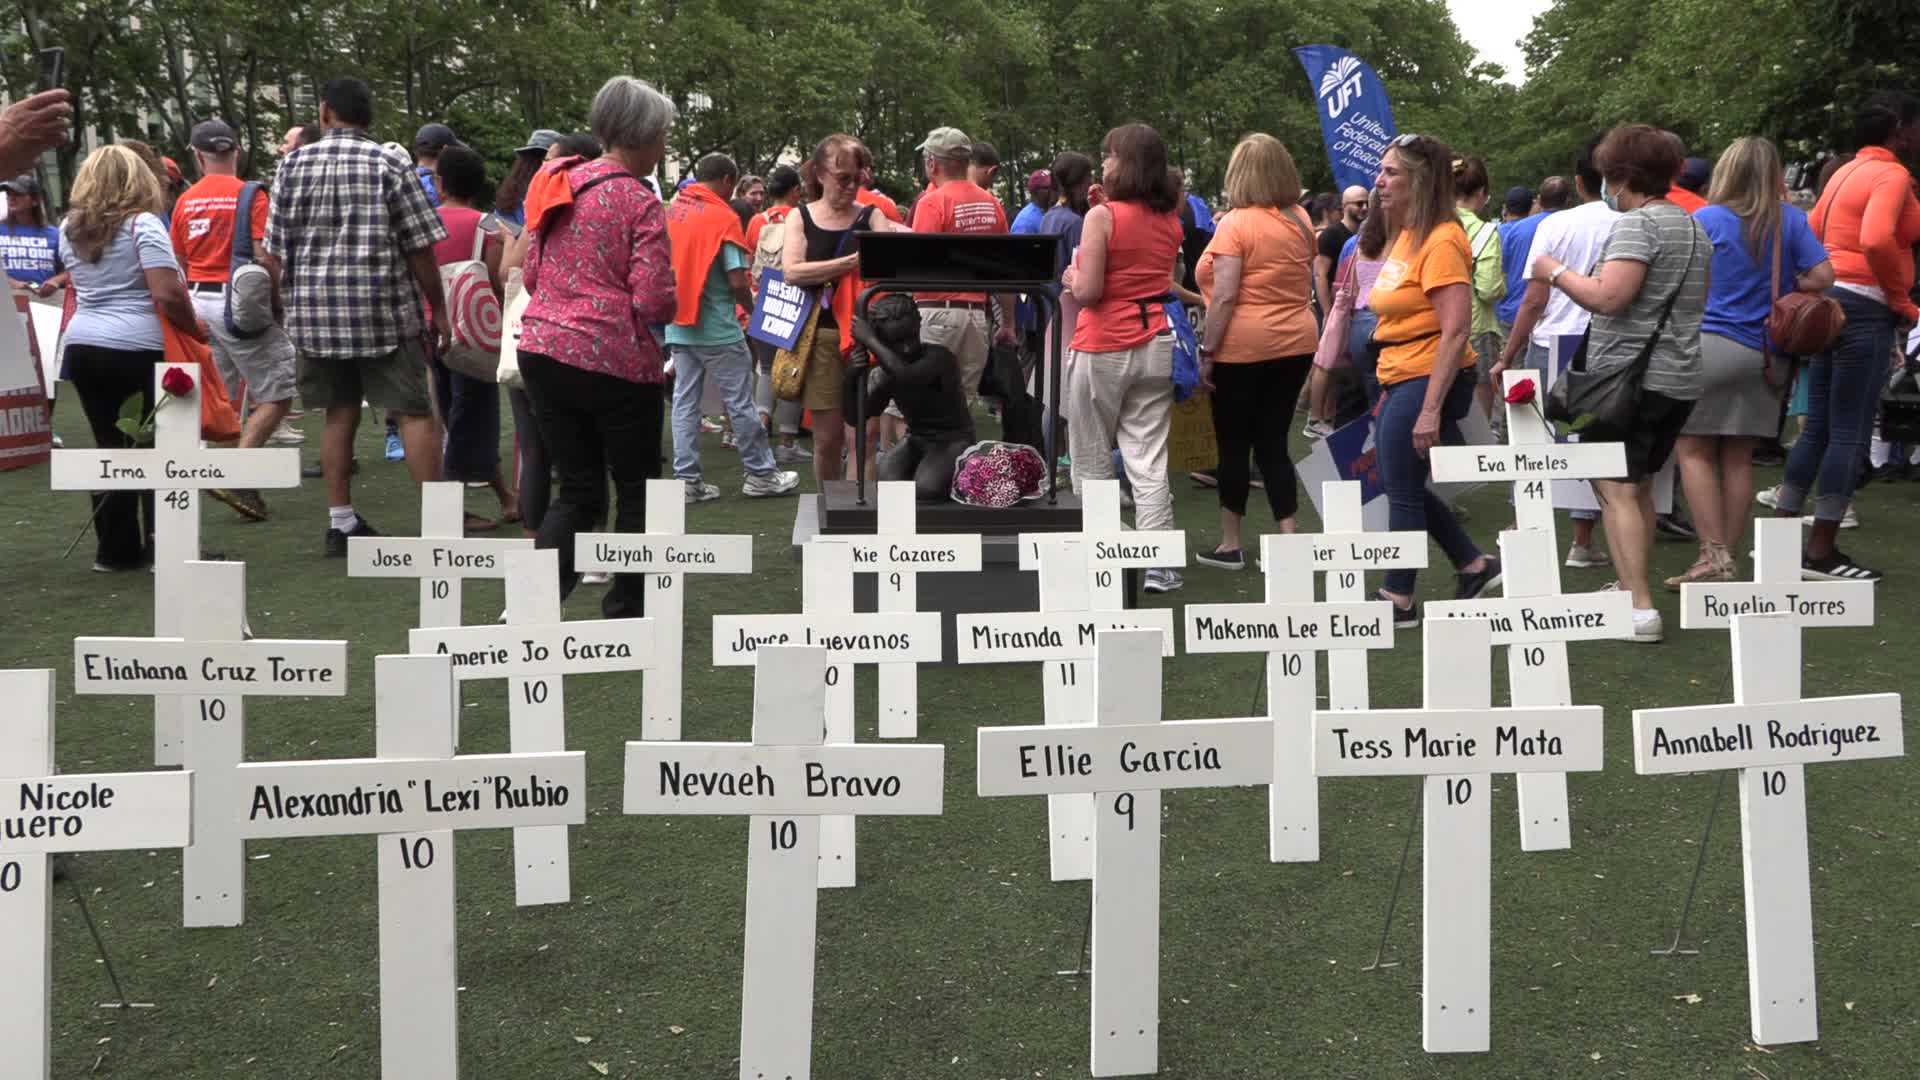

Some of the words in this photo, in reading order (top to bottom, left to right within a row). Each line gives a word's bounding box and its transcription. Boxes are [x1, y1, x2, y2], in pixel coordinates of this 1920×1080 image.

[1327, 71, 1362, 119] UFT
[1332, 139, 1353, 153] of
[0, 235, 48, 248] MARCH
[0, 246, 28, 258] FOR
[3, 258, 39, 270] LIVES
[780, 301, 802, 324] FOR
[99, 459, 146, 480] Irma
[165, 459, 225, 480] Garcia
[1477, 454, 1506, 472] Eva
[1515, 453, 1568, 471] Mireles
[164, 489, 190, 511] 48
[1523, 481, 1545, 499] 44
[371, 547, 413, 568] Jose
[432, 548, 496, 569] Flores
[595, 542, 654, 568] Uziyah
[664, 547, 716, 565] Garcia
[852, 547, 879, 563] kie
[889, 543, 957, 563] Cazares
[1095, 541, 1160, 560] Salazar
[1312, 545, 1336, 562] ier
[1350, 543, 1401, 566] Lopez
[431, 579, 450, 600] 10
[656, 574, 673, 591] 10
[889, 572, 902, 592] 9
[1095, 569, 1113, 588] 10
[1338, 572, 1357, 589] 10
[1785, 594, 1846, 616] Torres
[1194, 616, 1280, 642] Makenna
[1286, 614, 1319, 639] Lee
[1329, 613, 1382, 639] Elrod
[1520, 607, 1606, 632] Ramirez
[521, 639, 550, 663] Jo
[562, 635, 632, 661] Garza
[971, 624, 1064, 650] Miranda
[82, 652, 189, 682] Eliahana
[200, 656, 258, 683] Cruz
[266, 655, 334, 683] Torre
[1281, 652, 1303, 678] 10
[1523, 646, 1546, 667] 10
[824, 665, 840, 687] 0
[1060, 661, 1076, 687] 11
[522, 679, 549, 706] 10
[198, 697, 227, 723] 10
[1331, 727, 1394, 761] Tess
[1403, 726, 1477, 759] Marie
[1495, 725, 1564, 757] Mata
[1651, 722, 1754, 757] Annabell
[1767, 719, 1882, 757] Rodriguez
[1018, 743, 1093, 779] Ellie
[1119, 740, 1223, 776] Garcia
[658, 760, 776, 798] Nevaeh
[804, 761, 902, 798] Bravo
[1445, 777, 1473, 807] 10
[1761, 769, 1787, 798] 10
[19, 781, 115, 812] Nicole
[248, 782, 405, 822] Alexandria
[494, 774, 570, 811] Rubio
[1113, 791, 1137, 832] 9
[0, 814, 84, 842] uero
[769, 819, 798, 852] 10
[398, 836, 435, 870] 10
[0, 860, 22, 893] 0
